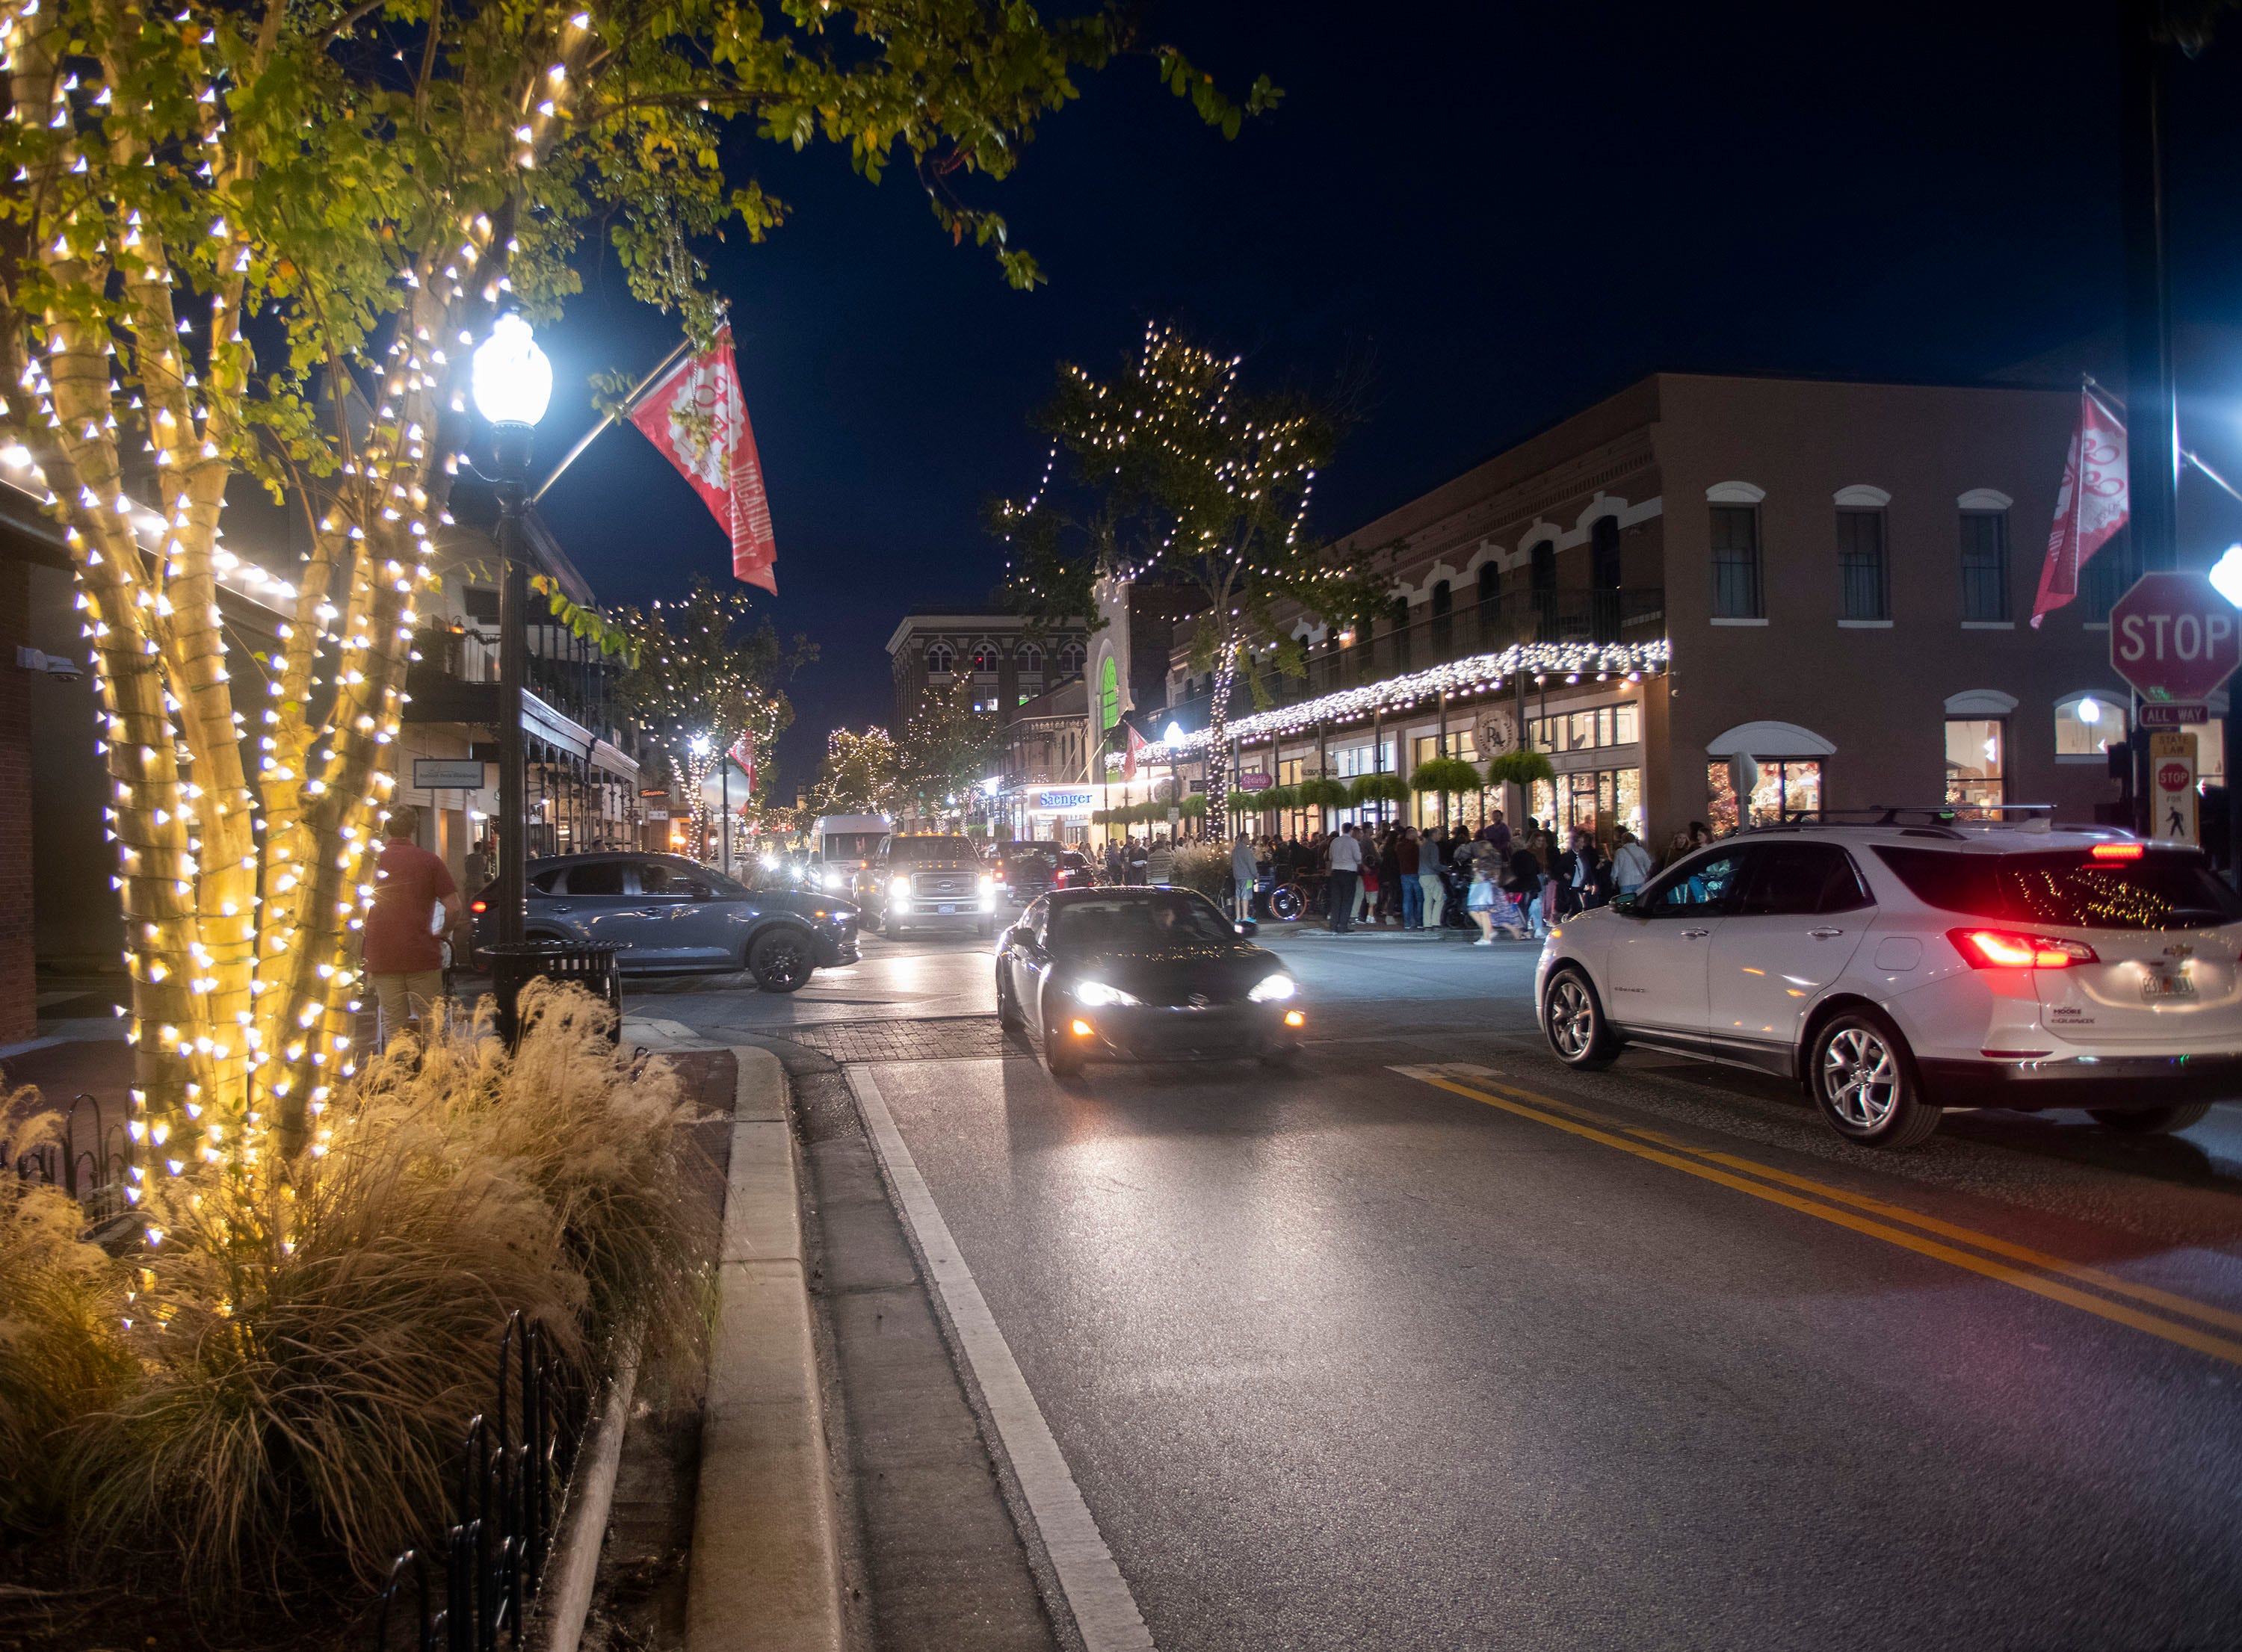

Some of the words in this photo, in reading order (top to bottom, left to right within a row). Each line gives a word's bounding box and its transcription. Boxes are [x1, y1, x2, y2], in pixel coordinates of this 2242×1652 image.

[732, 461, 774, 544] VACATION
[2119, 614, 2232, 661] STOP
[2147, 708, 2170, 722] ALL
[2177, 708, 2202, 722] WAY
[2159, 735, 2188, 745] STATE
[2163, 746, 2184, 755] LAW
[2160, 772, 2188, 784] STOP
[1040, 792, 1093, 807] Saenger
